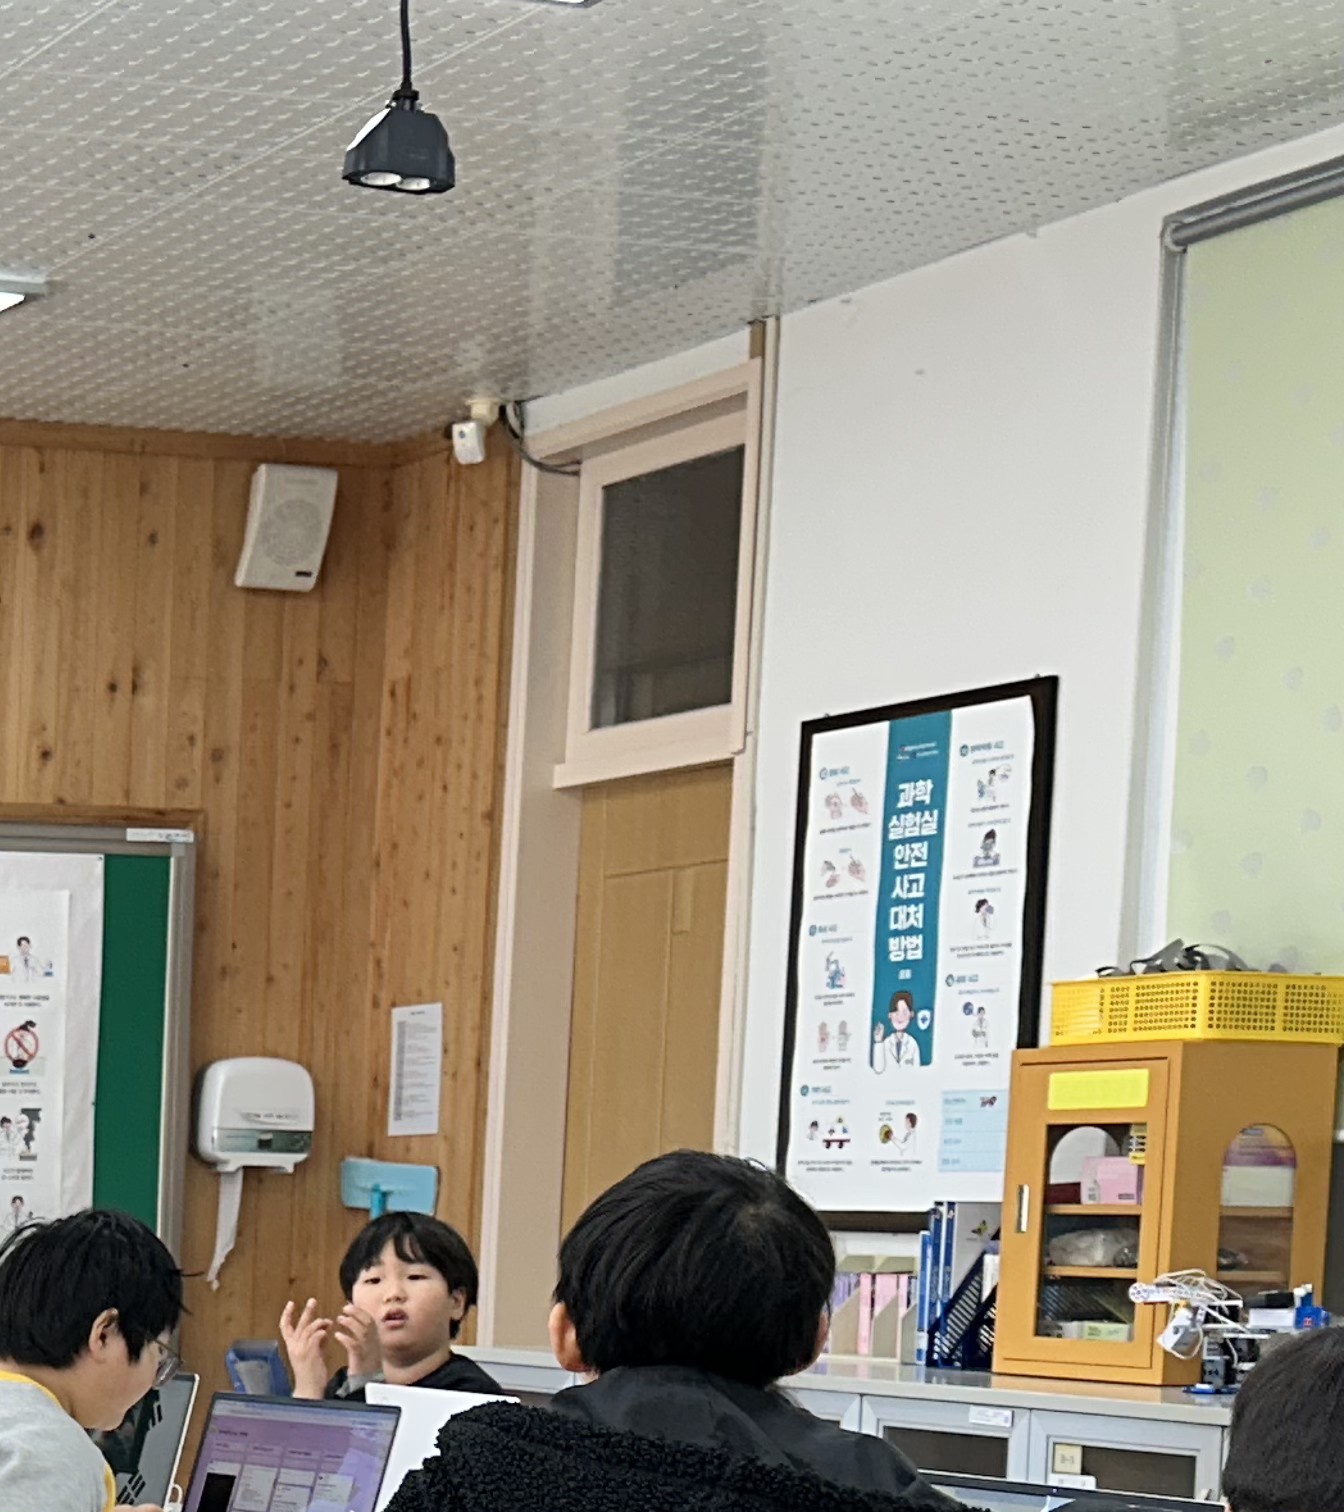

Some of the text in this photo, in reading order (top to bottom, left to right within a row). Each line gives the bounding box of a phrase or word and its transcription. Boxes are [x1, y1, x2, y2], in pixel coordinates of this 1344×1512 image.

[897, 778, 934, 808] 과학
[887, 810, 939, 840] 실험실
[893, 841, 929, 869] 안전
[891, 872, 926, 900] 사고
[889, 903, 924, 931] 대처
[888, 934, 923, 962] 방법
